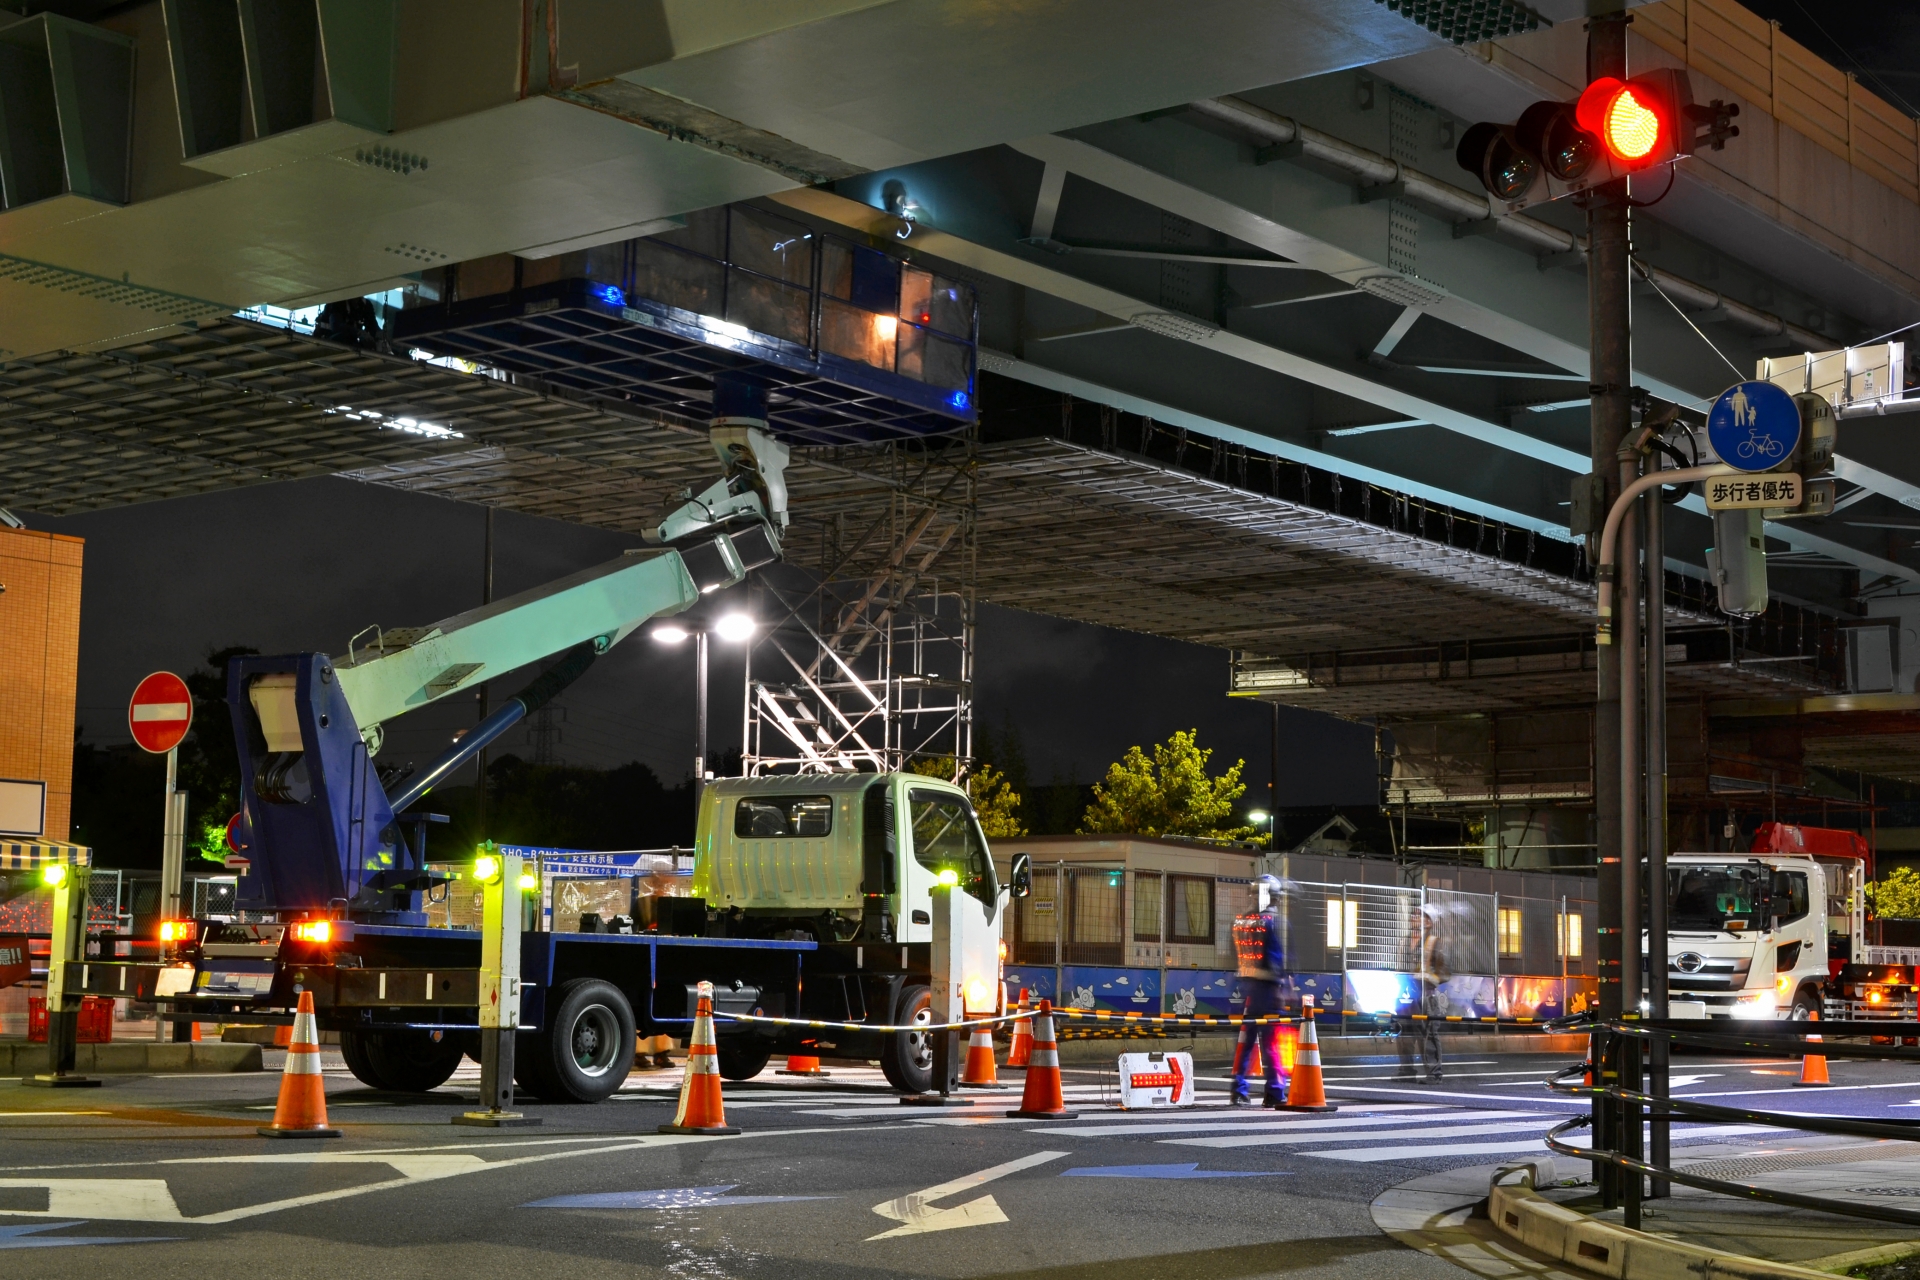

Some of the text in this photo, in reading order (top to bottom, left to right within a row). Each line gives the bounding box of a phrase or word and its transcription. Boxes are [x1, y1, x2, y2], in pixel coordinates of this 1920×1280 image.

[1713, 481, 1794, 502] 歩行者優先
